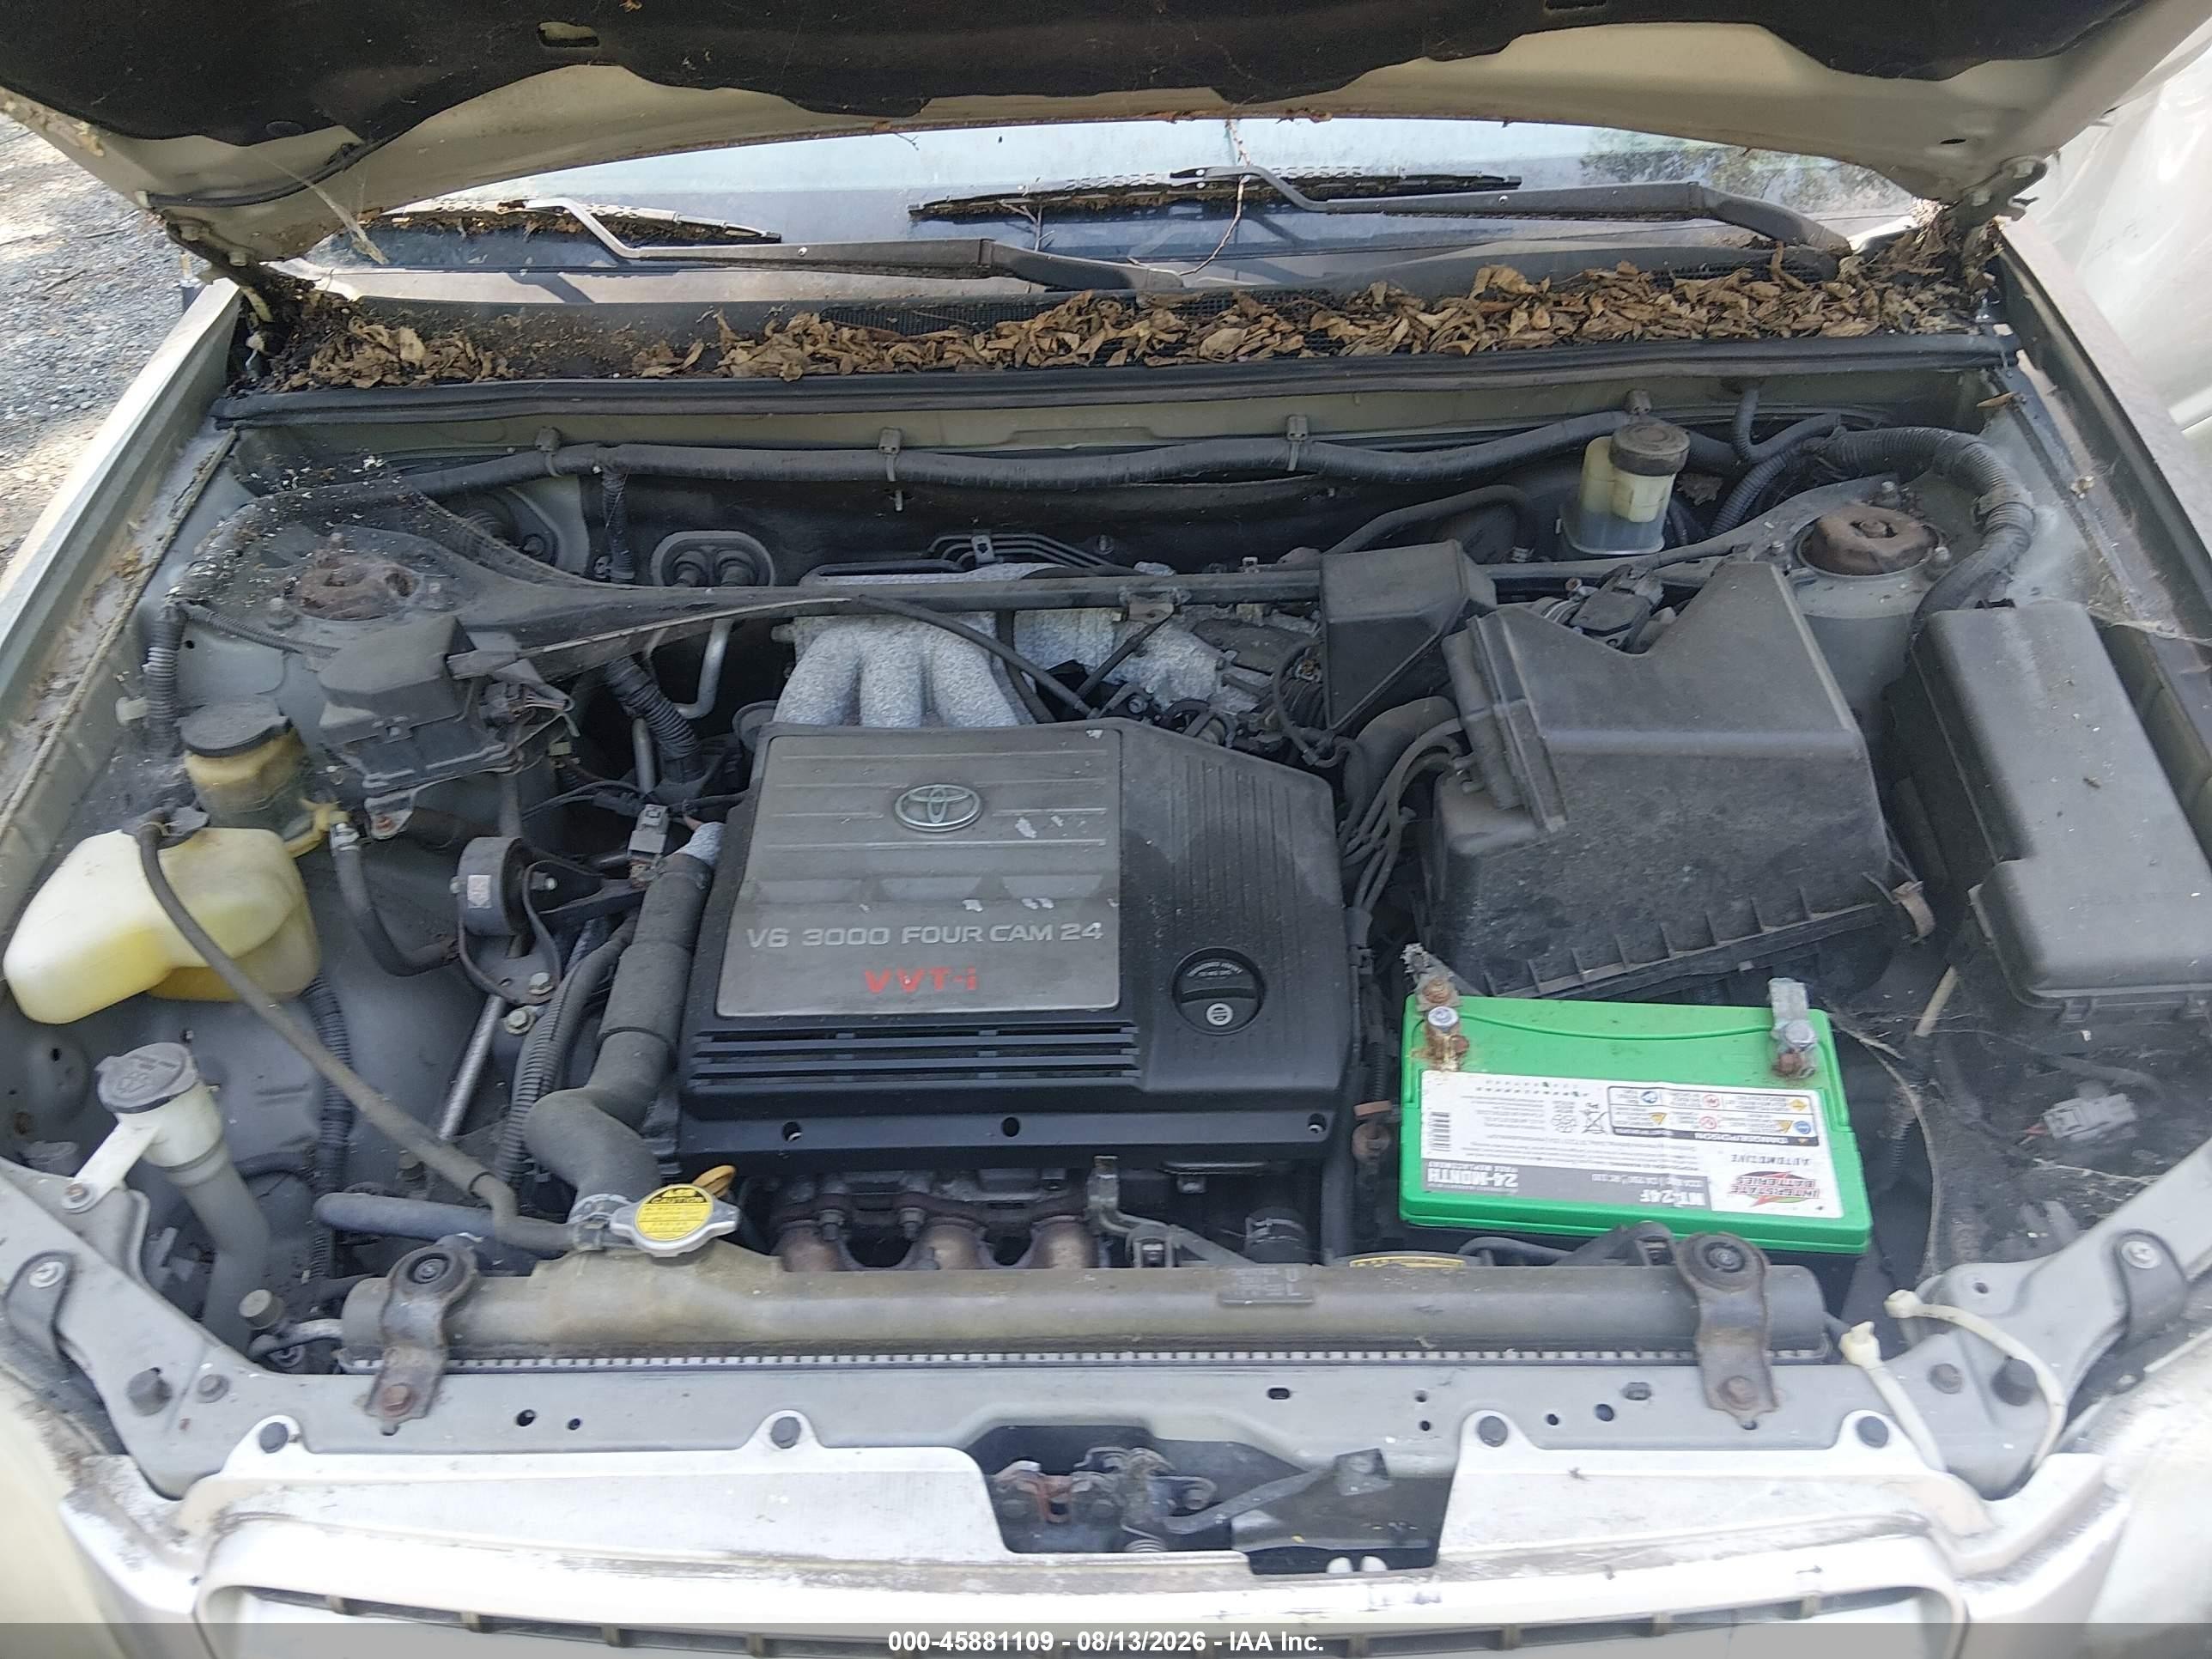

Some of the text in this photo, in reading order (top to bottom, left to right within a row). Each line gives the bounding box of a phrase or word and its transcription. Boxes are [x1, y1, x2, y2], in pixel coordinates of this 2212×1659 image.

[747, 923, 1104, 947] V6 3000 FOUR CAM 24
[864, 966, 978, 994] VVT-i
[1731, 1154, 1810, 1165] AUTOMOTIVE
[1427, 1168, 1519, 1188] 24-MONTH
[1737, 1176, 1815, 1188] BATTERIES
[1731, 1185, 1820, 1199] INTERSTATE
